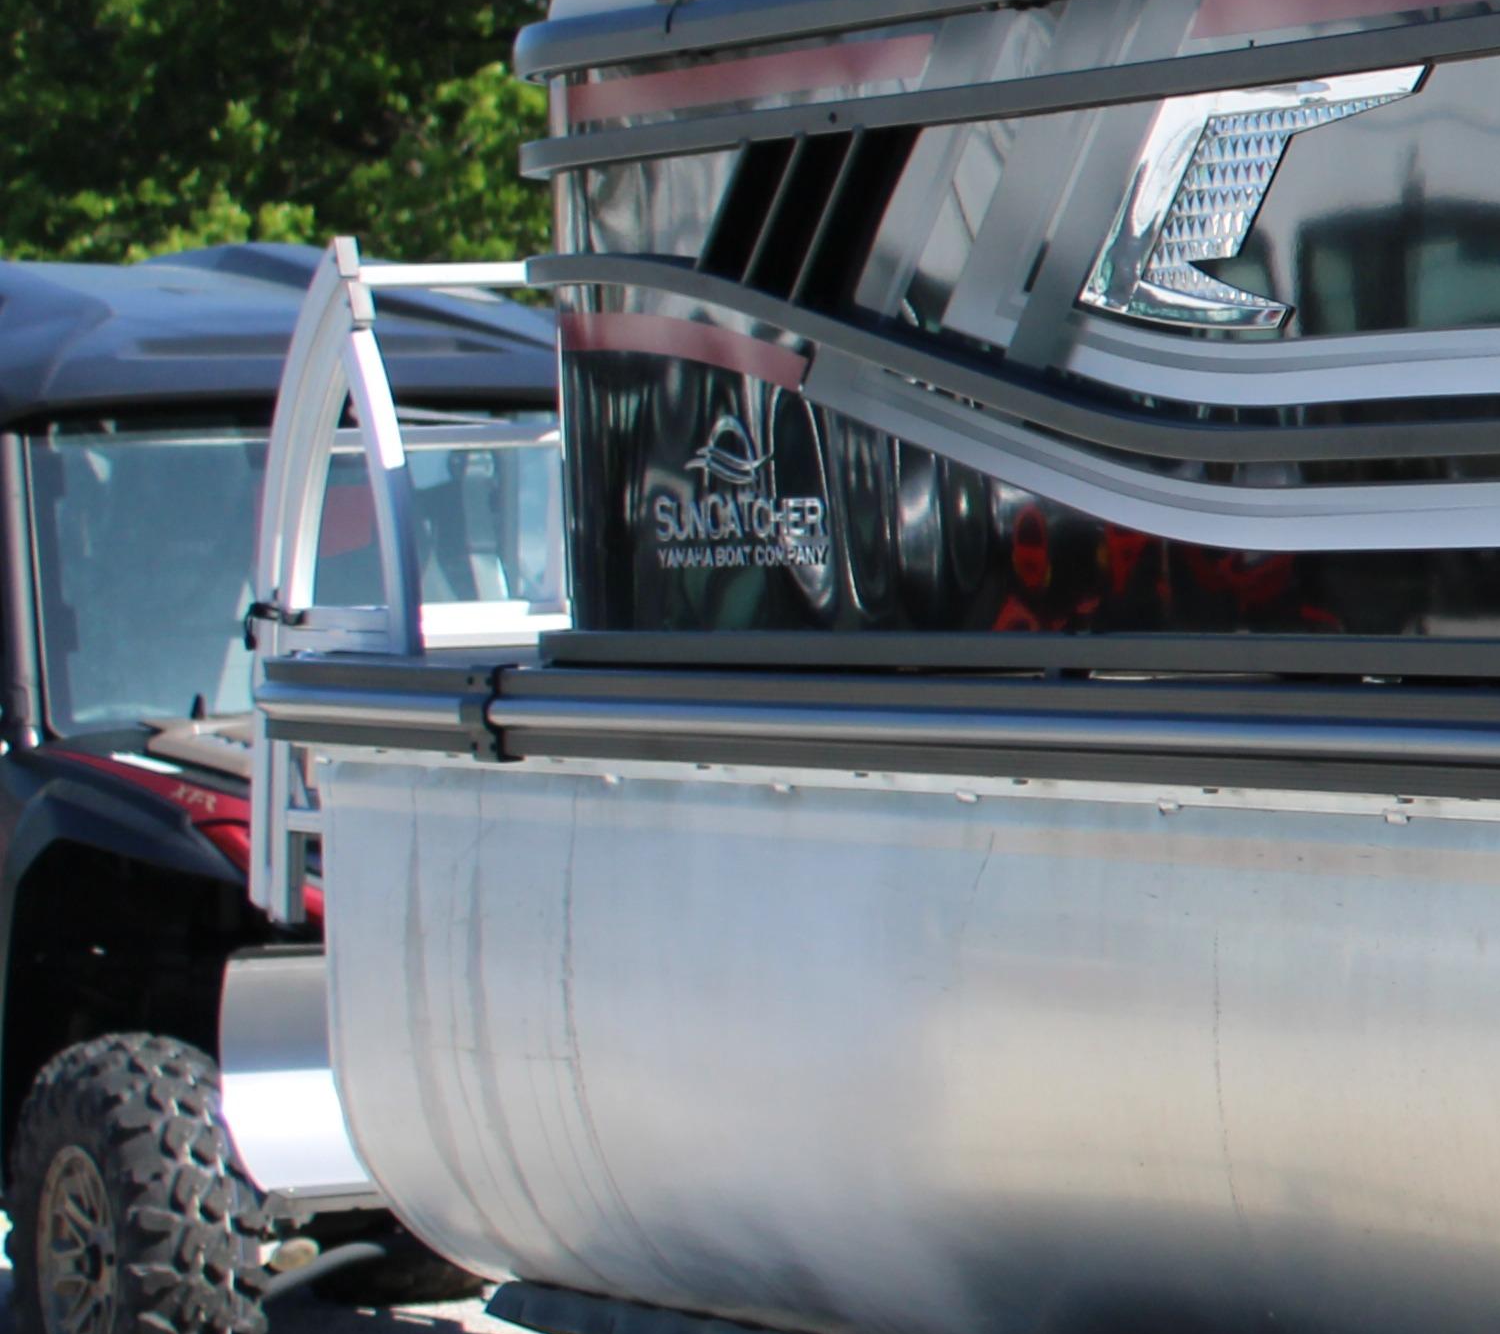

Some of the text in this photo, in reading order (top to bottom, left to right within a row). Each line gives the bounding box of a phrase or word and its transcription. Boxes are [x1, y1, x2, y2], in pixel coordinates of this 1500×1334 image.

[655, 492, 829, 542] SUNCATCHER
[657, 544, 830, 568] YAMAHA BOAT COMPANY
